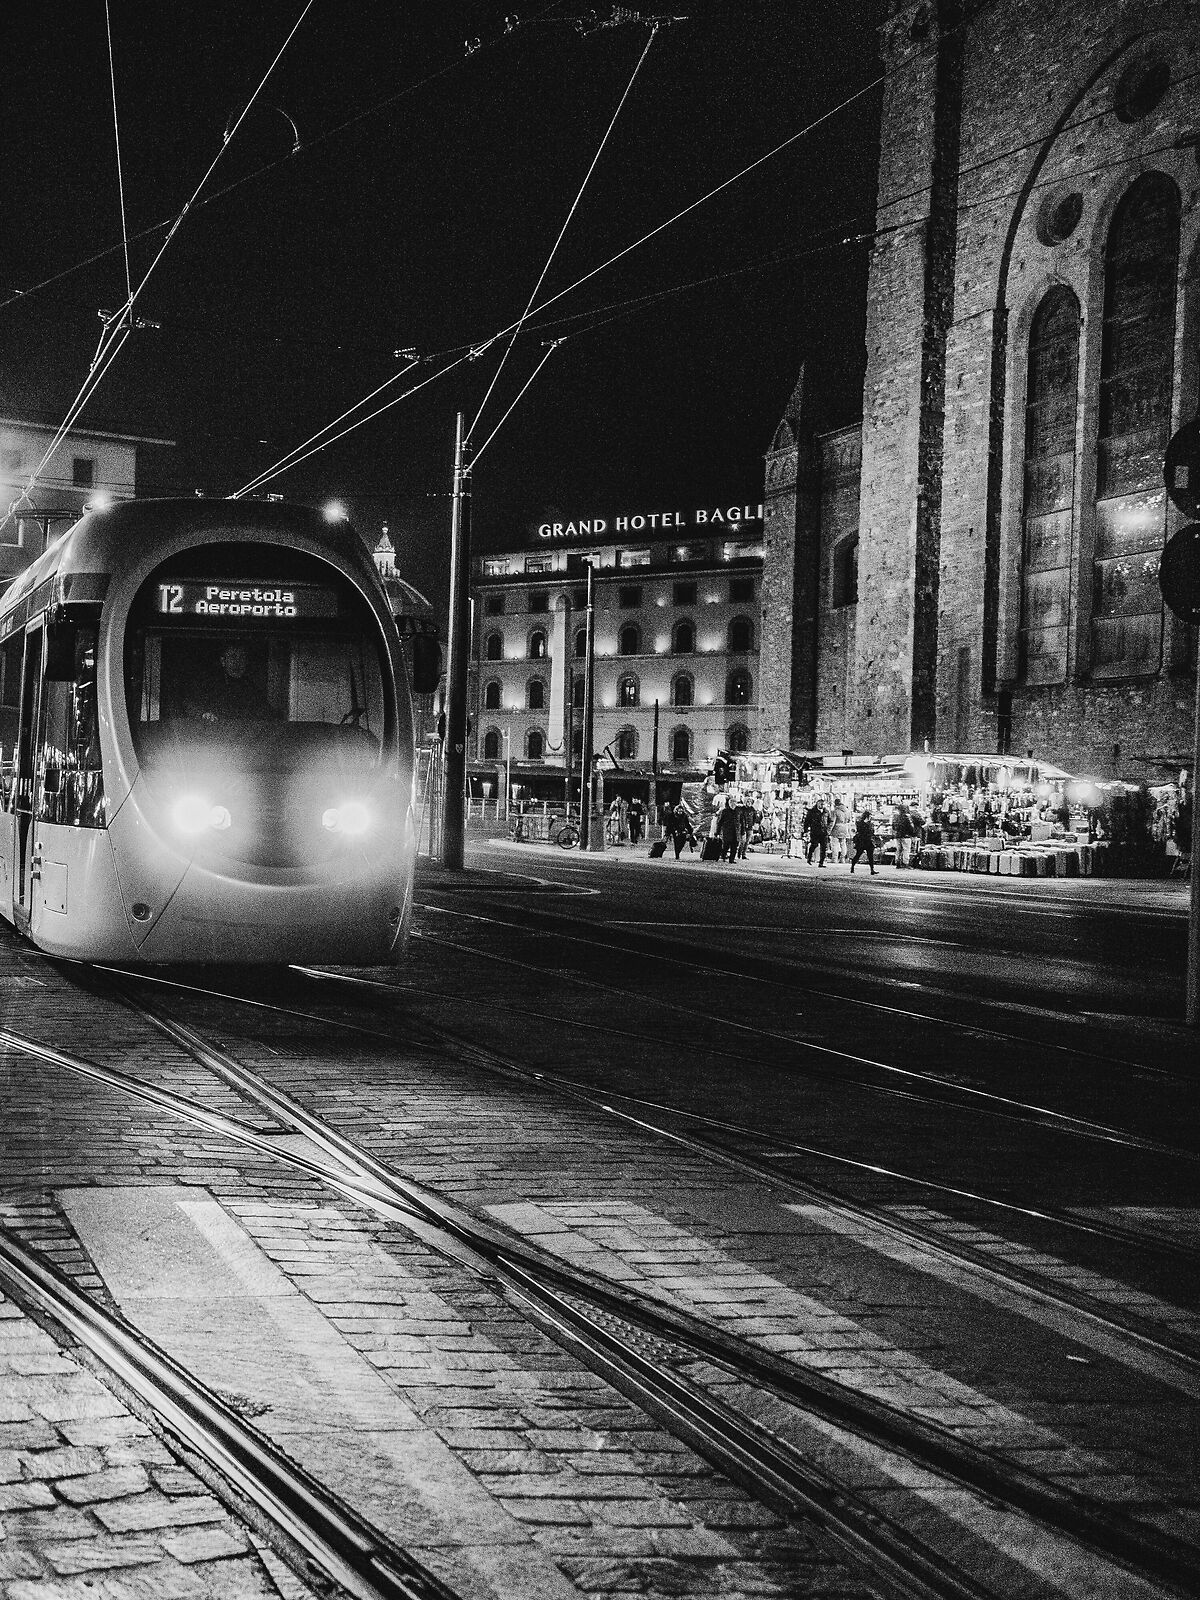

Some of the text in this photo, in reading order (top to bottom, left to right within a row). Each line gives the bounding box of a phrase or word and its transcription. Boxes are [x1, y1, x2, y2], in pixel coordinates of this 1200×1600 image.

[539, 504, 763, 538] GRAND HOTEL BAGLI
[159, 584, 183, 613] T2
[206, 586, 294, 603] Peretola
[195, 600, 297, 616] Aeroporto
